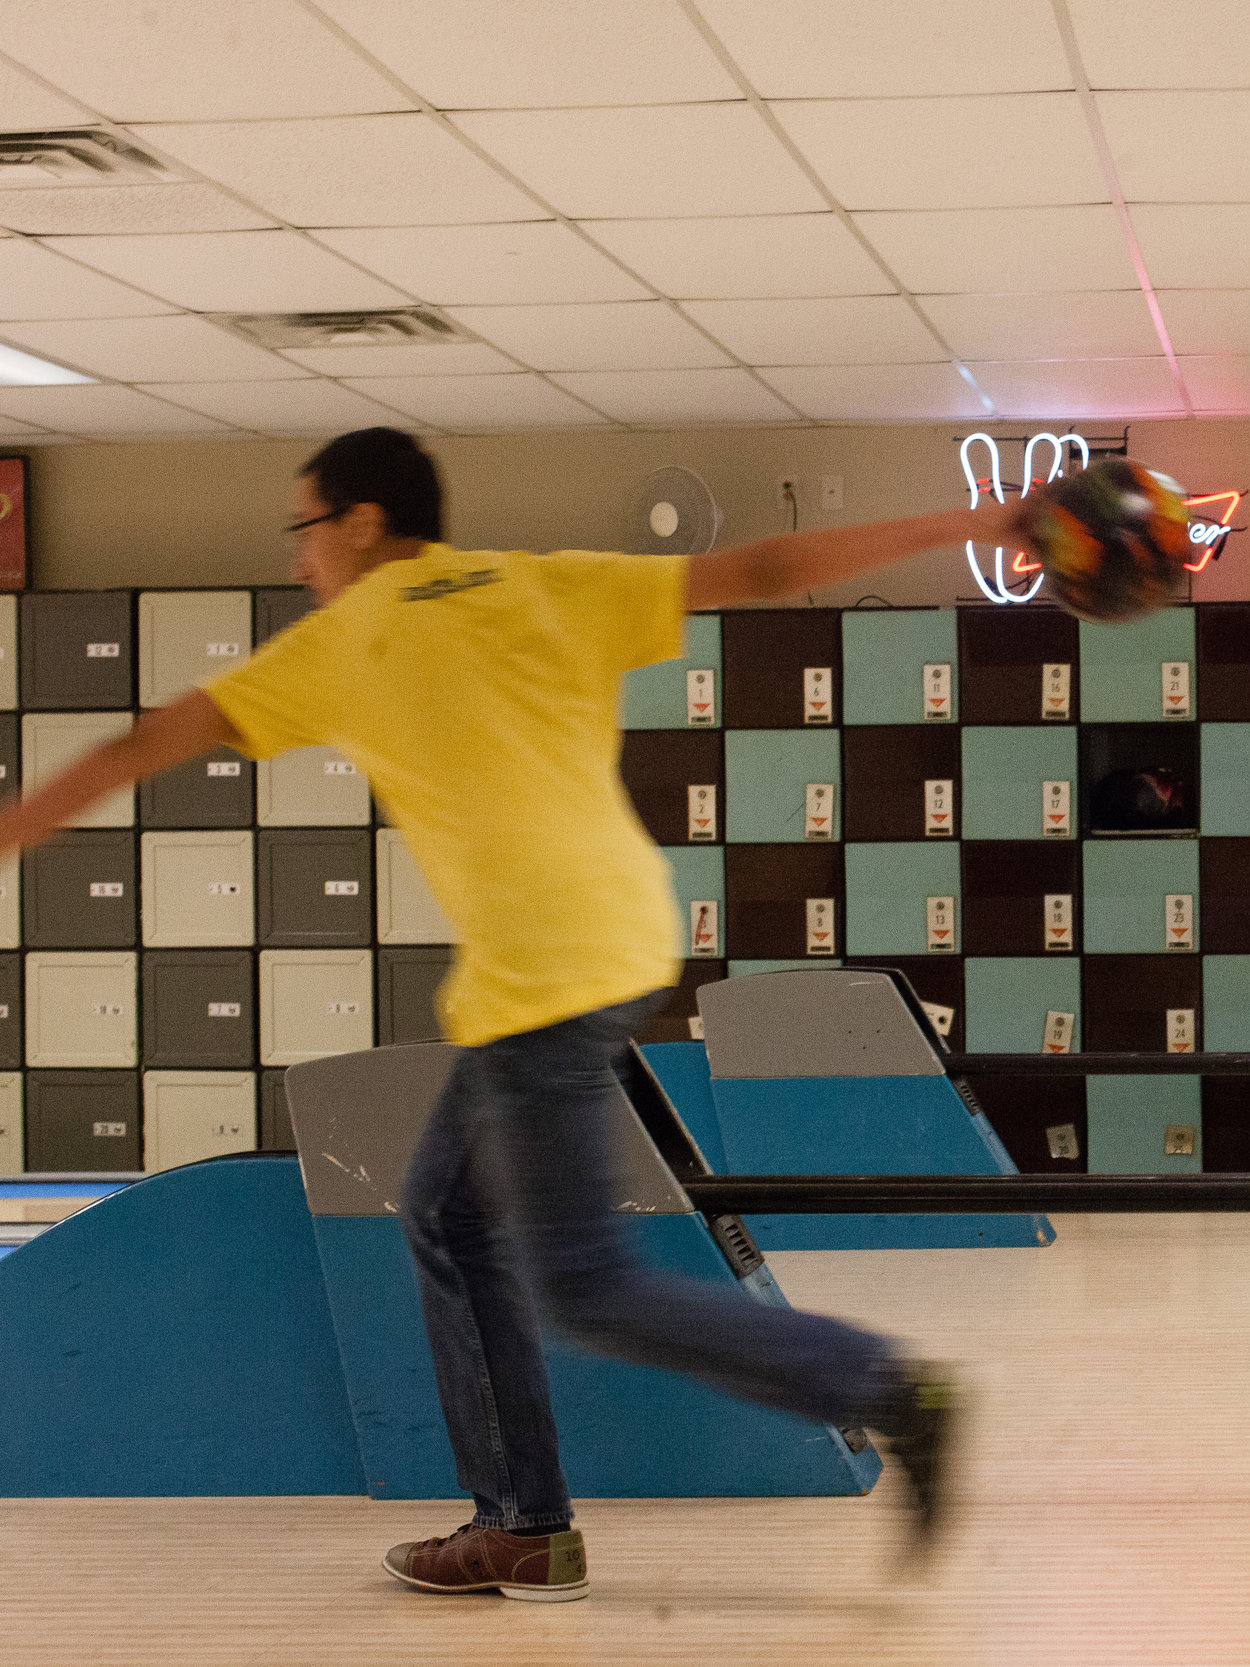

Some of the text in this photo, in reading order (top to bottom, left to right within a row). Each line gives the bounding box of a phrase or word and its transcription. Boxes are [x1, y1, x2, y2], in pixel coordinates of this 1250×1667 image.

[933, 683, 941, 693] 11
[1170, 681, 1180, 691] 21
[814, 687, 820, 697] 6
[815, 802, 822, 812] 7
[933, 798, 944, 809] 12
[1050, 799, 1060, 809] 17
[698, 803, 705, 815] 2
[935, 915, 945, 925] 13
[1052, 913, 1063, 923] 18
[1173, 913, 1185, 924] 23
[1053, 1029, 1062, 1041] 19
[1175, 1028, 1186, 1039] 24
